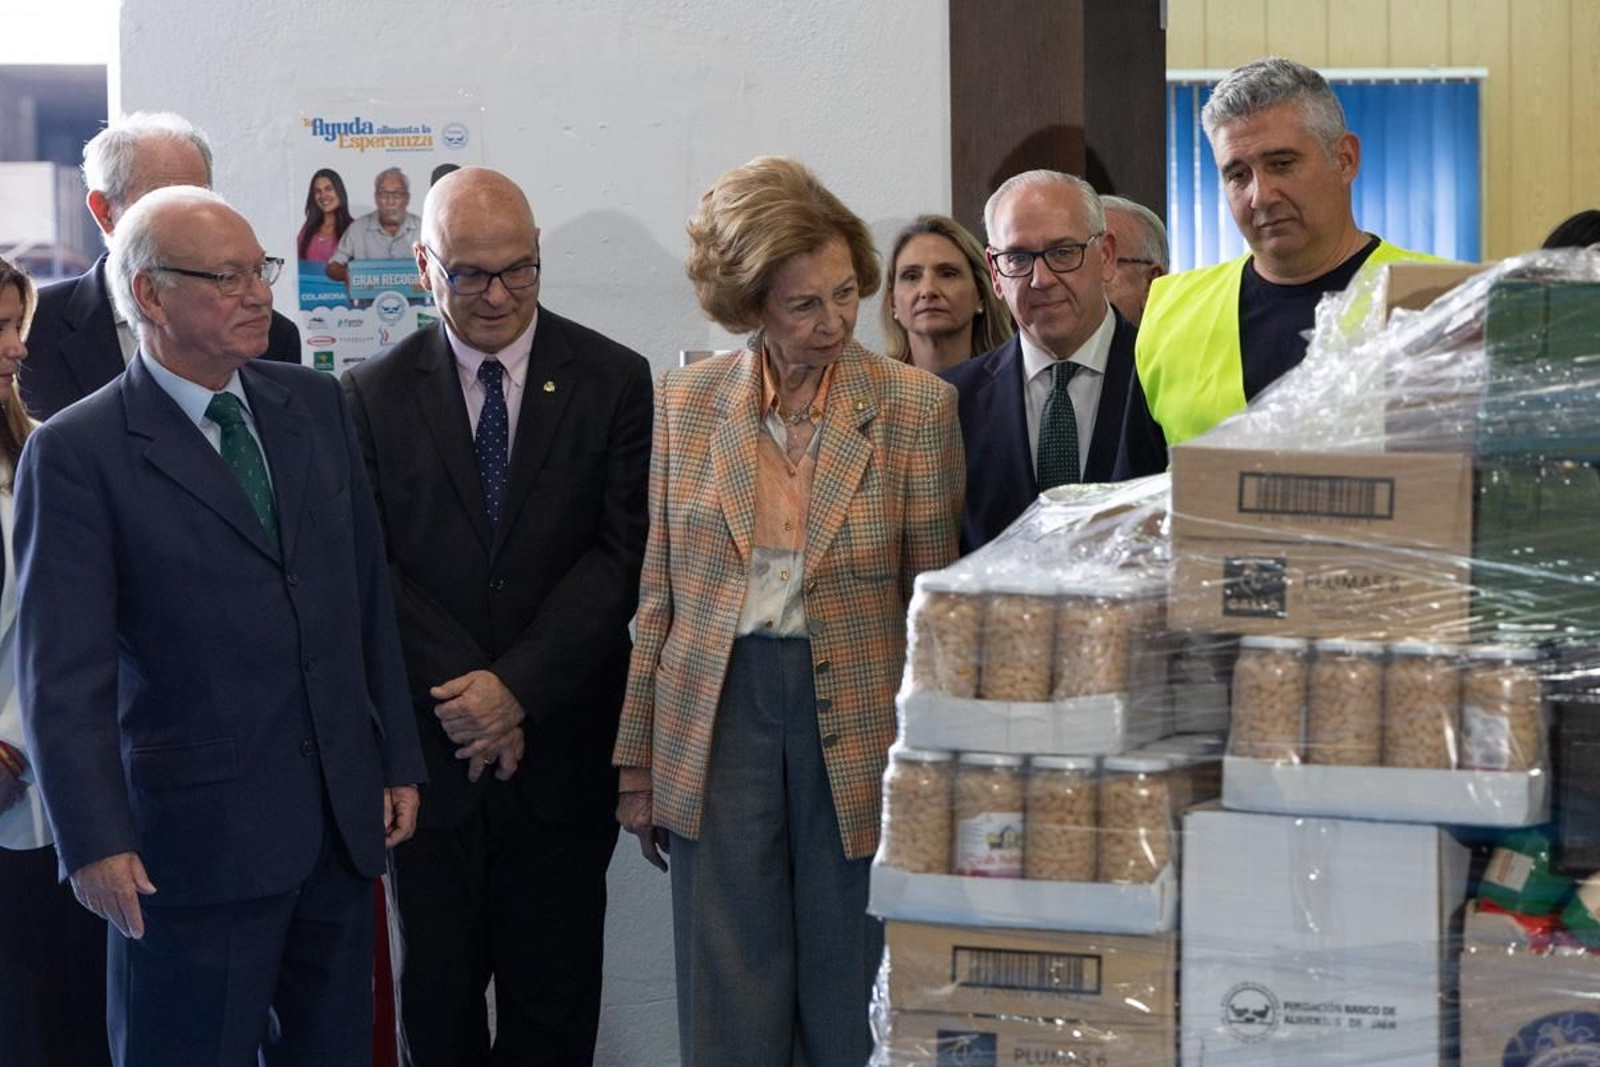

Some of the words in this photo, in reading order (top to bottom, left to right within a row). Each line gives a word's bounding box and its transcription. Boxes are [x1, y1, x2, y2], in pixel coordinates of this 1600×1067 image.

[312, 117, 374, 142] Ayuda
[376, 125, 420, 134] alimenta
[422, 124, 432, 133] la
[338, 133, 434, 153] Esperanza
[353, 275, 380, 286] GRAN
[1344, 1005, 1380, 1015] BANCO
[1382, 1006, 1396, 1016] DE
